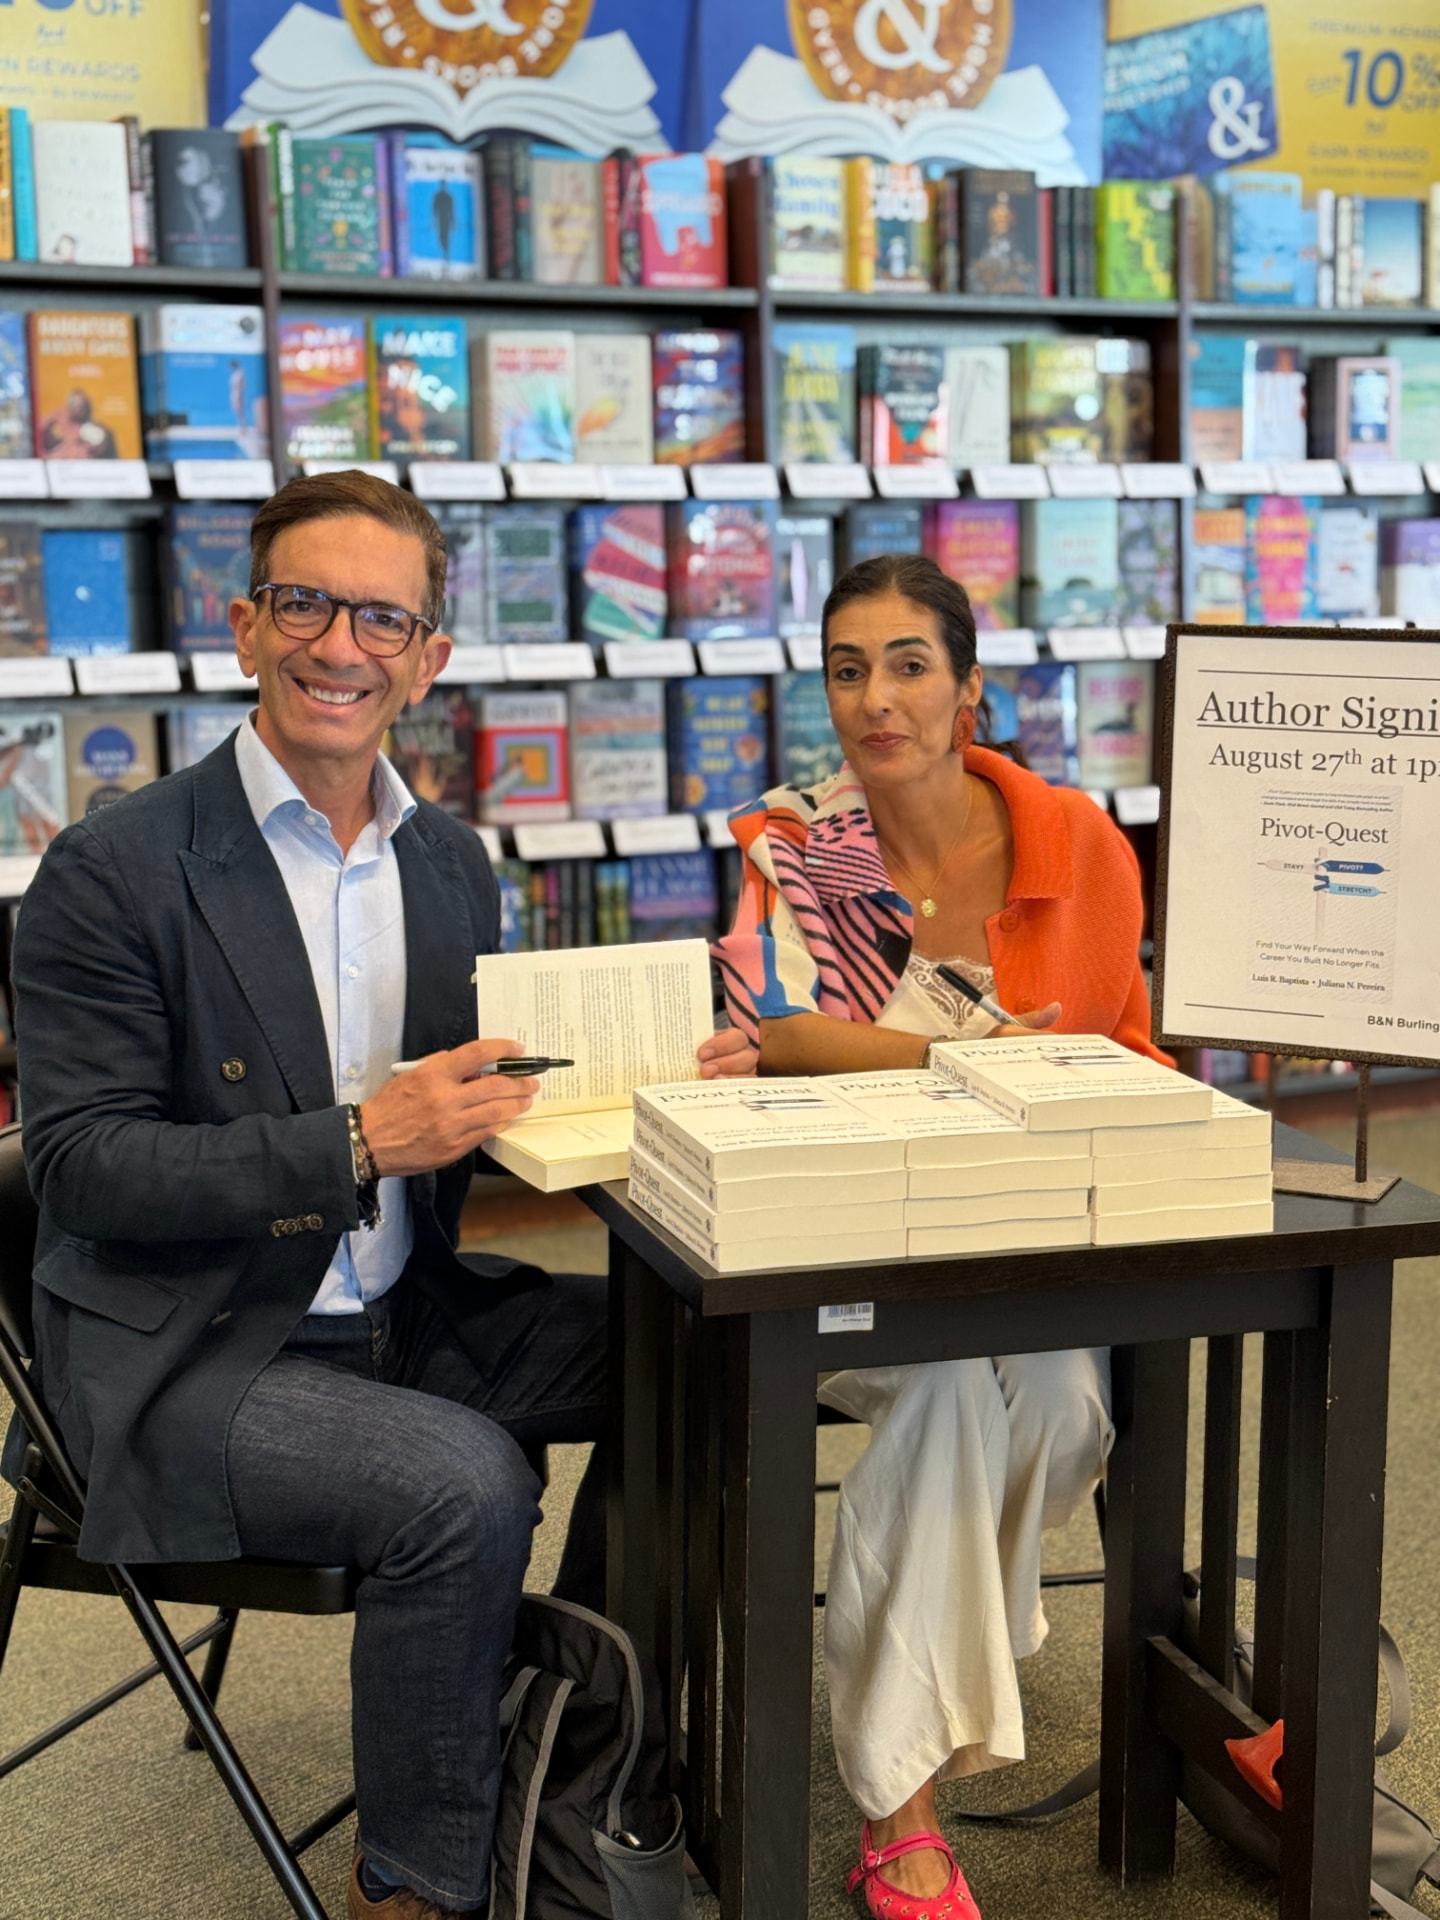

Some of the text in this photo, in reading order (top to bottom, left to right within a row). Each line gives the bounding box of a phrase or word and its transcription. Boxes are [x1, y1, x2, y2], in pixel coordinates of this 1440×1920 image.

[1208, 76, 1271, 160] &
[383, 330, 459, 358] MAKE
[387, 364, 458, 413] NICE
[1196, 691, 1331, 727] Author
[1208, 743, 1440, 783] August 27th at 1p
[1260, 818, 1389, 846] Pivot-Quest
[1338, 886, 1372, 894] STRETCH?
[1255, 940, 1384, 957] Find Your Way Forward When the
[1260, 953, 1379, 969] Career You Built No Longer Fits
[1252, 973, 1269, 982] Luis
[1279, 976, 1309, 985] Baptista
[1317, 978, 1345, 988] Juliana
[1357, 982, 1385, 991] Pereira
[1367, 1015, 1440, 1033] B&N Burling
[960, 1043, 1110, 1058] Pivot-Quest
[934, 1055, 968, 1088] Pivot-Quest
[658, 1087, 816, 1104] Pivot-Quest
[838, 1079, 953, 1093] Pivot-Qu
[635, 1101, 664, 1136] Pivot-Quest
[636, 1128, 665, 1163] Pivot-Quest
[630, 1155, 661, 1193] Pivot-Quest
[632, 1182, 663, 1221] Pivot-Quest
